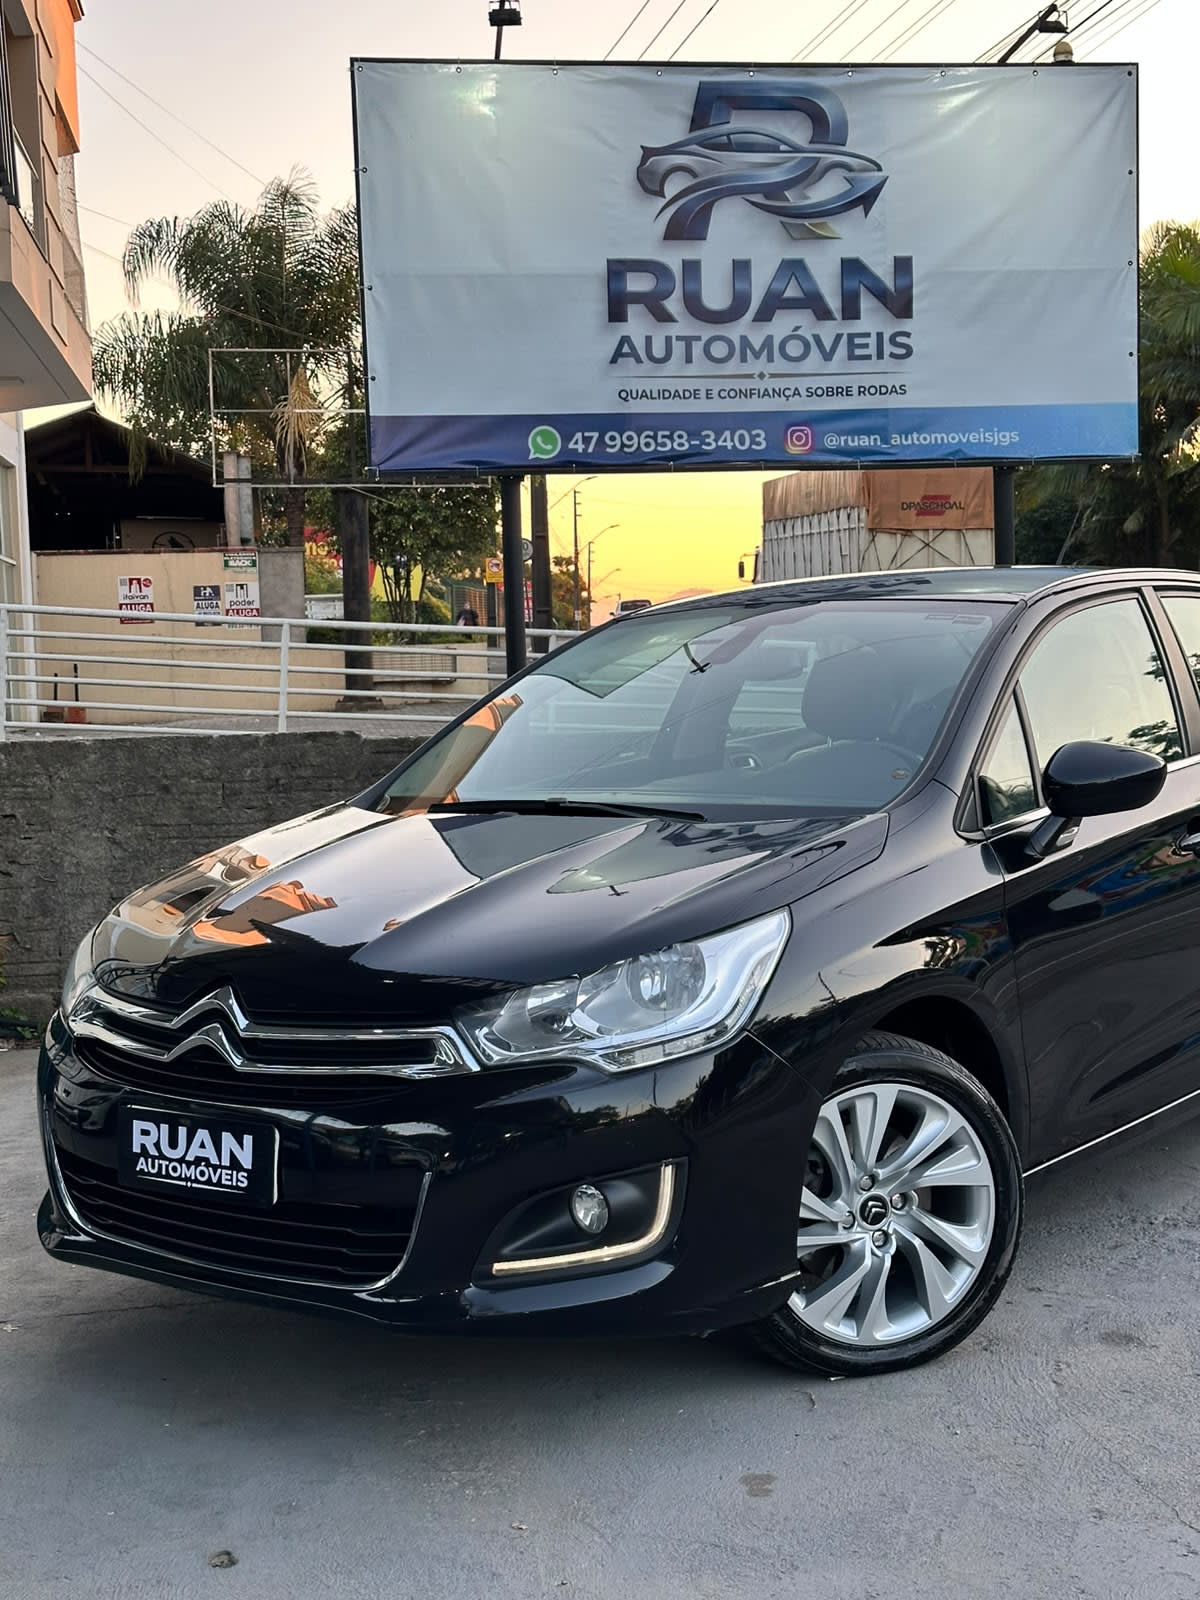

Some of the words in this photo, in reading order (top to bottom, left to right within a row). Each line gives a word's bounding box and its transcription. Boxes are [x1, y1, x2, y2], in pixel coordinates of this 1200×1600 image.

[606, 256, 914, 324] RUAN
[609, 325, 914, 364] AUTOMÓVEIS
[618, 388, 701, 401] QUALIDADE
[705, 388, 714, 400] E
[717, 387, 802, 401] CONFIANÇA
[805, 385, 854, 398] SOBRE
[857, 384, 907, 397] RODAS
[567, 431, 600, 453] 47
[604, 429, 768, 453] 99658-3403
[823, 428, 1020, 449] @ruan_automoveisjgs
[901, 500, 965, 511] DPASCHOAL
[195, 601, 220, 610] ALUGA
[227, 608, 259, 617] ALUGA
[229, 599, 255, 608] poder
[132, 1119, 253, 1170] RUAN
[136, 1157, 248, 1188] AUTOMÓVEIS
